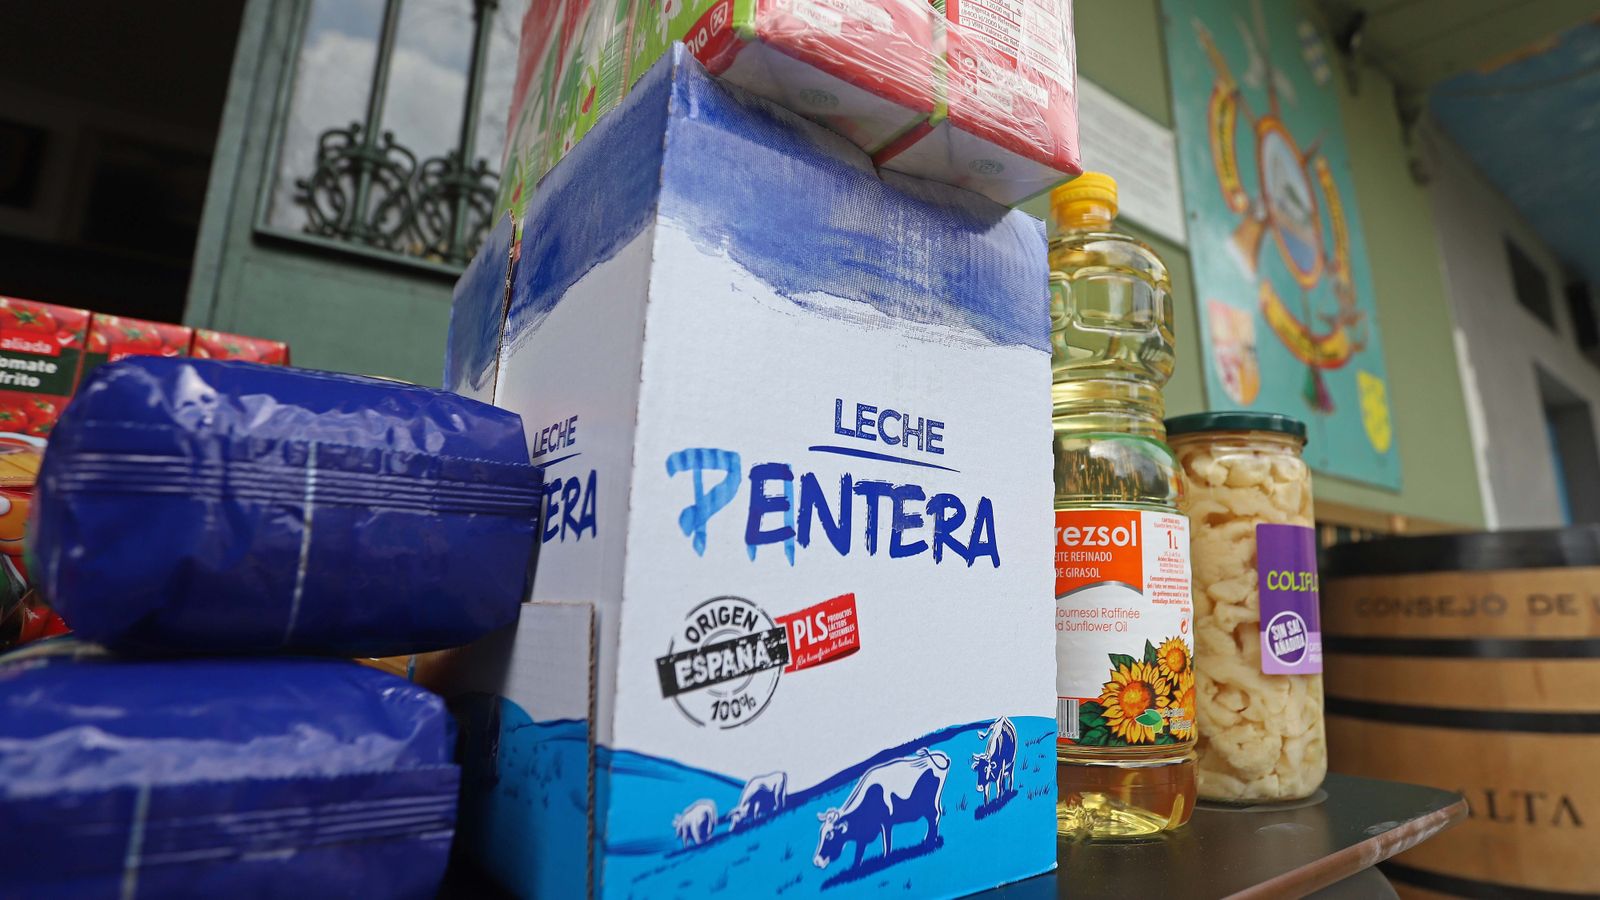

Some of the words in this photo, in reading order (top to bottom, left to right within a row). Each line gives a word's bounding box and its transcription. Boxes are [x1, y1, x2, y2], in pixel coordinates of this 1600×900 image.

[0, 357, 58, 374] omate
[532, 415, 578, 459] LECHE
[834, 398, 945, 455] LECHE
[1055, 520, 1137, 547] rezsol
[1071, 551, 1112, 562] REFINADO
[1065, 567, 1101, 578] GIRASOL
[1101, 606, 1140, 619] Raffinée
[1355, 592, 1508, 618] CONSEJO
[1527, 593, 1579, 617] DE
[685, 606, 759, 644] ORIGEN
[793, 611, 829, 650] PLS
[1065, 620, 1112, 632] Sunflower
[1114, 620, 1128, 632] Oil
[1270, 622, 1288, 641] SIN
[1286, 619, 1302, 636] SAL
[674, 630, 770, 690] ESPAÑA
[711, 692, 756, 721] 100%
